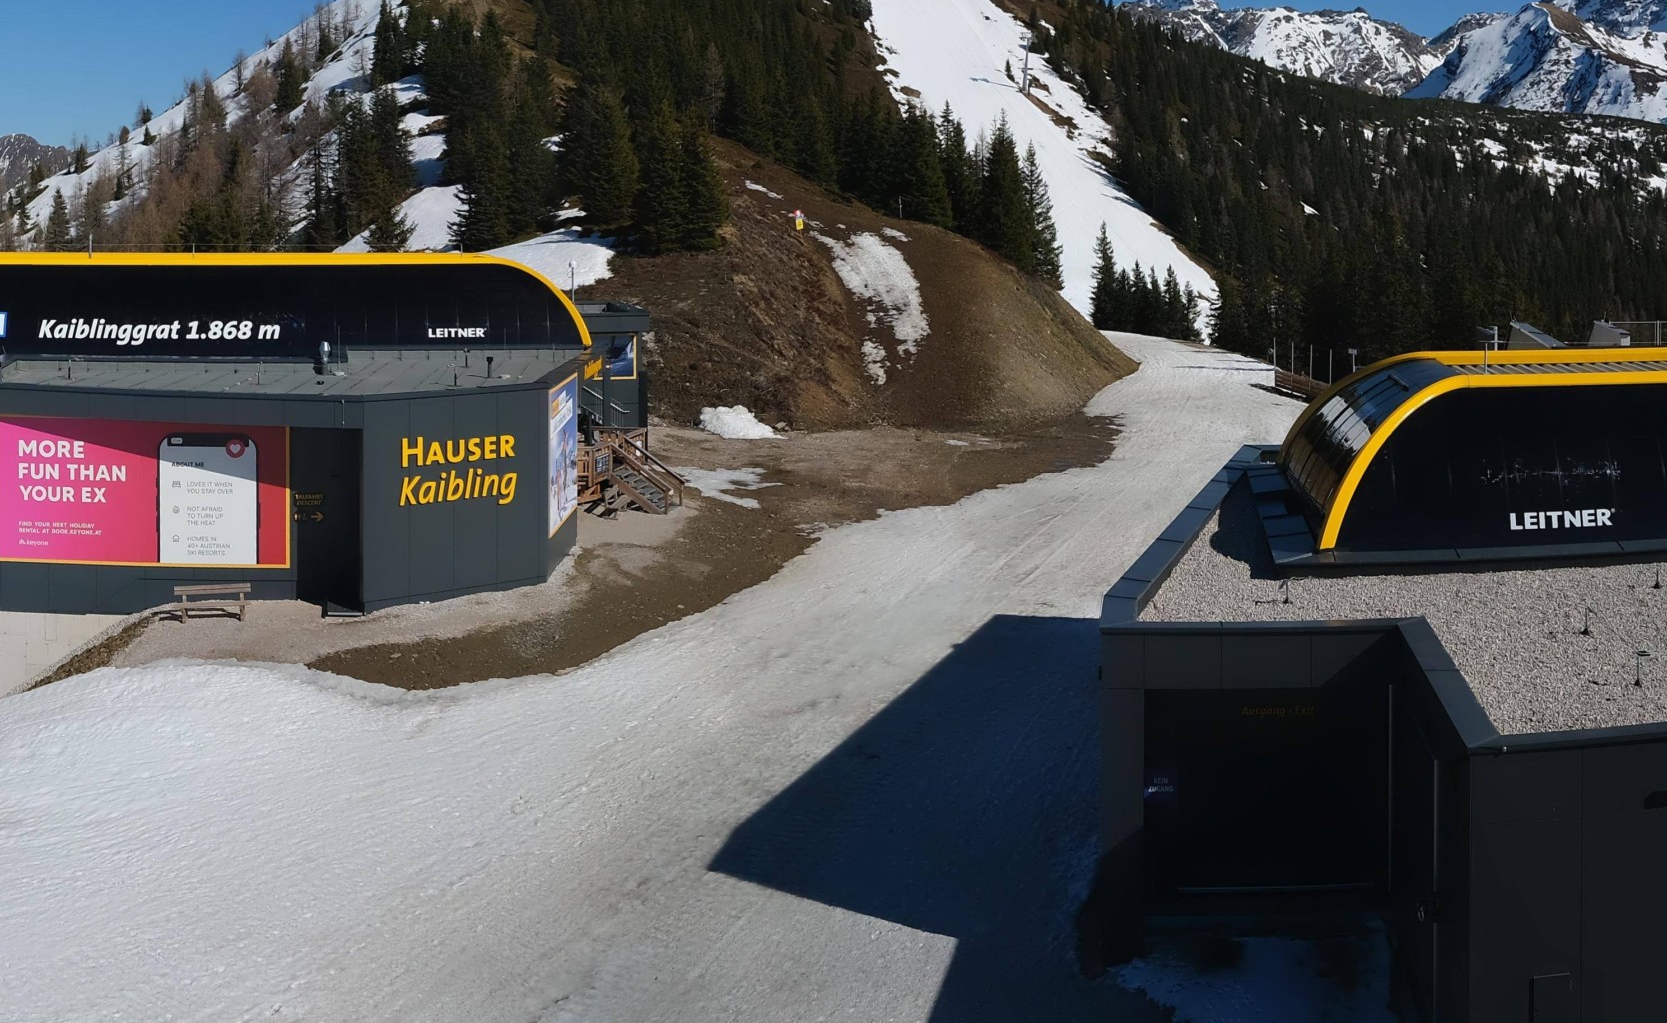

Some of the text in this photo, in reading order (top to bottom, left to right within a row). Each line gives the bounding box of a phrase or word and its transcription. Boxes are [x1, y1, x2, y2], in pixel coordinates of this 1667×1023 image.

[39, 318, 280, 345] Kaiblinggrat 1.868 m
[428, 328, 486, 338] LEITNER
[18, 440, 85, 458] MORE
[402, 435, 516, 468] HAUSER
[18, 463, 126, 482] FUN THAN
[19, 485, 107, 503] YOUR EX
[400, 468, 518, 506] Kaibling
[1510, 509, 1613, 530] LEITNER
[26, 539, 49, 547] keyone
[1242, 707, 1286, 718] Ausgang
[1295, 705, 1314, 714] Exit
